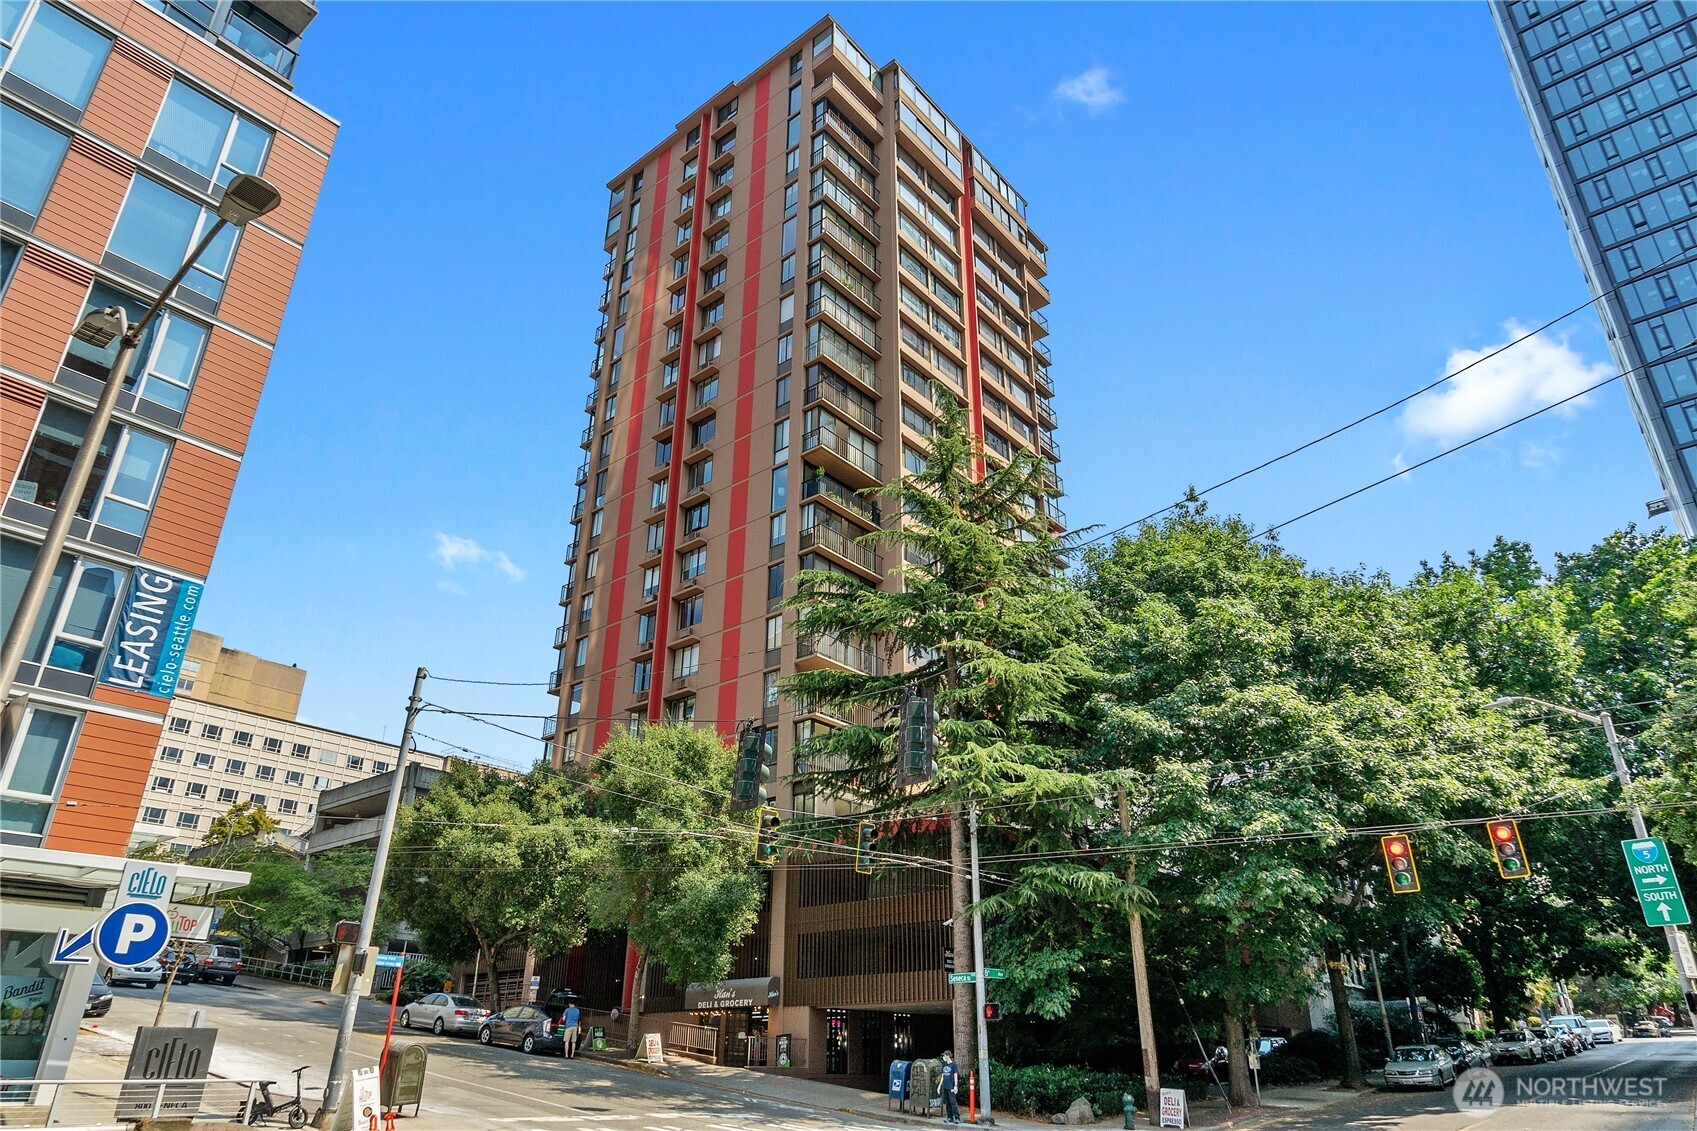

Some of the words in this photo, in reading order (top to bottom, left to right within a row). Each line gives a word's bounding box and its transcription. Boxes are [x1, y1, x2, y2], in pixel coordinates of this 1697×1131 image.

[108, 573, 173, 688] LEASING
[157, 585, 200, 694] cielo-seattle.com
[1643, 851, 1650, 859] 5
[1634, 863, 1668, 874] NORTH
[1643, 891, 1677, 902] SOUTH
[115, 913, 156, 954] P
[950, 974, 967, 982] Seneca
[4, 979, 45, 1000] Bandit
[697, 1001, 712, 1009] DELI
[720, 999, 753, 1007] GROCERY
[1164, 1096, 1176, 1106] DELI
[1162, 1106, 1182, 1117] GROCERY
[1162, 1117, 1182, 1125] ESPRESSO
